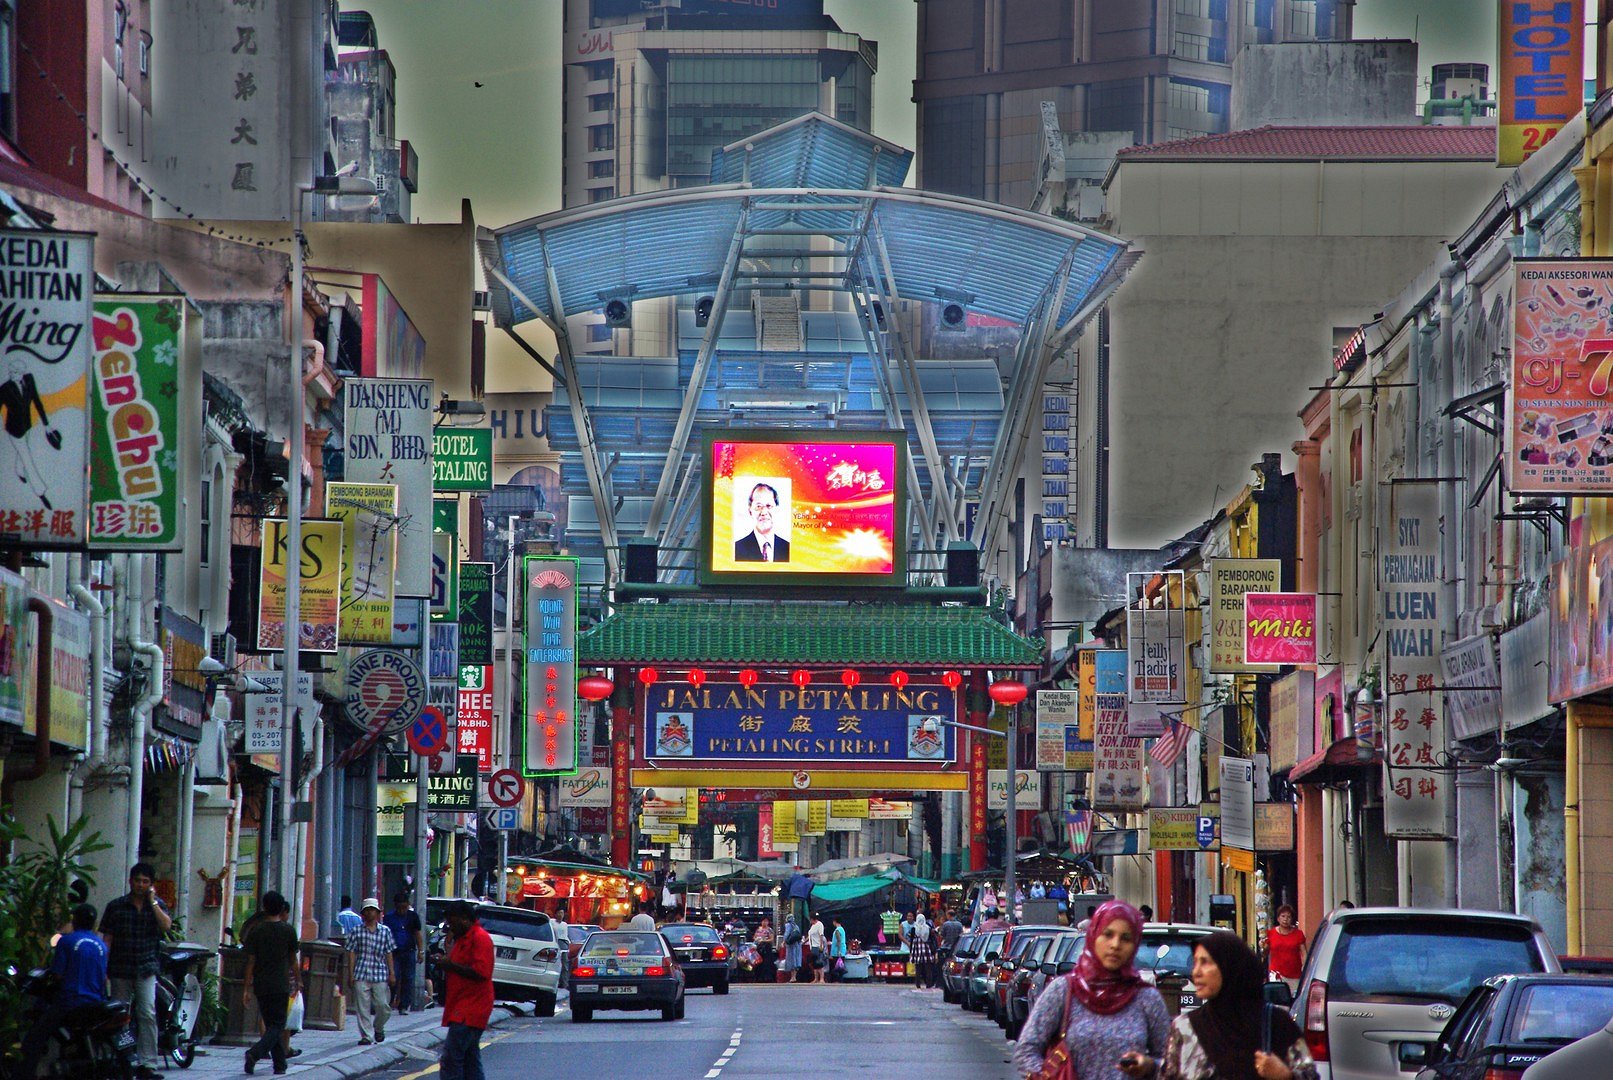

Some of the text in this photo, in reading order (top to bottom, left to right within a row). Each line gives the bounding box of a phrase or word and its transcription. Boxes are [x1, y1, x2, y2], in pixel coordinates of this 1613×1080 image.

[1512, 2, 1572, 121] HOTEL
[1521, 271, 1547, 279] KEDAI
[1548, 271, 1590, 279] AKSESORI
[349, 384, 429, 410] DAISHENG
[1044, 396, 1068, 411] KEDAI
[1532, 400, 1561, 408] SEVEN
[1565, 400, 1583, 408] SDN
[1045, 414, 1068, 430] UBAT
[350, 435, 383, 459] SDN.
[1045, 480, 1067, 495] THAI
[1045, 502, 1064, 517] SDN
[95, 504, 160, 534] 珍珠
[1045, 524, 1064, 540] BHD
[1399, 518, 1420, 547] SYKT
[1217, 570, 1275, 581] PEMBORONG
[1384, 555, 1436, 583] PERNIAGAAN
[1221, 584, 1271, 595] BARANGAN
[1385, 591, 1437, 620] LUEN
[1249, 619, 1312, 637] Miki
[1390, 628, 1434, 657] WAH
[347, 654, 380, 688] NINE
[660, 688, 940, 711] JALAN PETALING
[1099, 711, 1121, 722] NEW
[1097, 723, 1118, 735] KEY
[709, 738, 891, 754] PETALING STREET
[1099, 735, 1141, 748] SDN. BHD.
[1097, 760, 1140, 770] 有限公司
[502, 811, 513, 826] P
[1200, 817, 1213, 832] P
